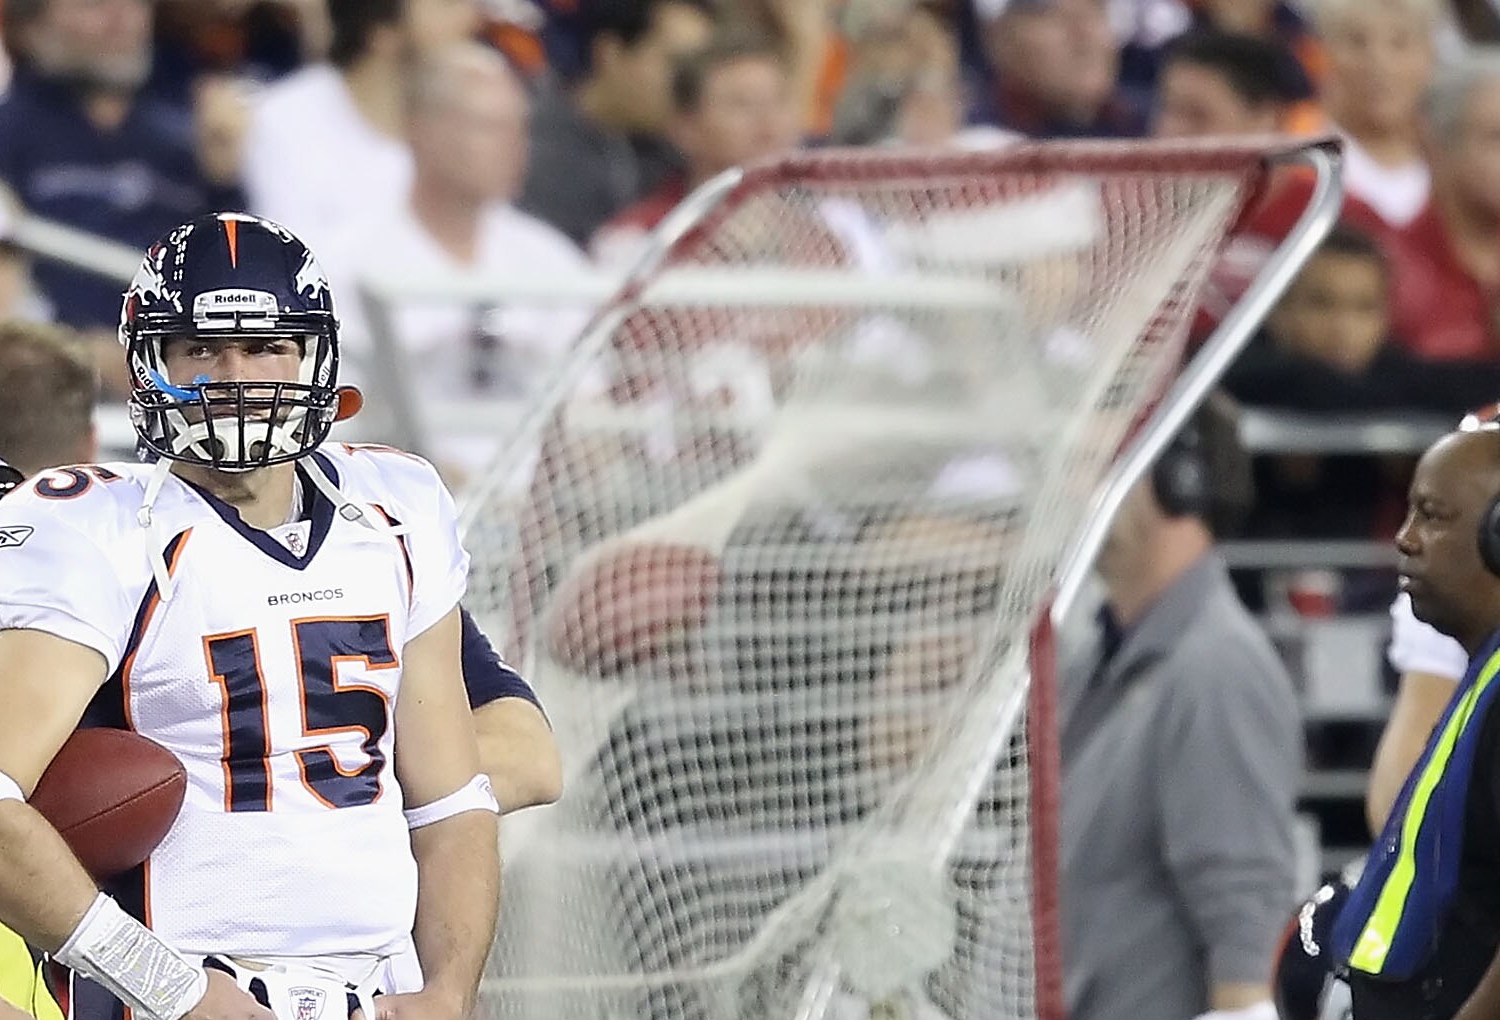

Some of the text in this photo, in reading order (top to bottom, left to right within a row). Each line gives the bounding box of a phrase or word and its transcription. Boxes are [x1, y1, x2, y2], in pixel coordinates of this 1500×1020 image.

[214, 294, 257, 304] Riddell
[268, 588, 344, 606] BRONCOS
[202, 613, 400, 813] 15
